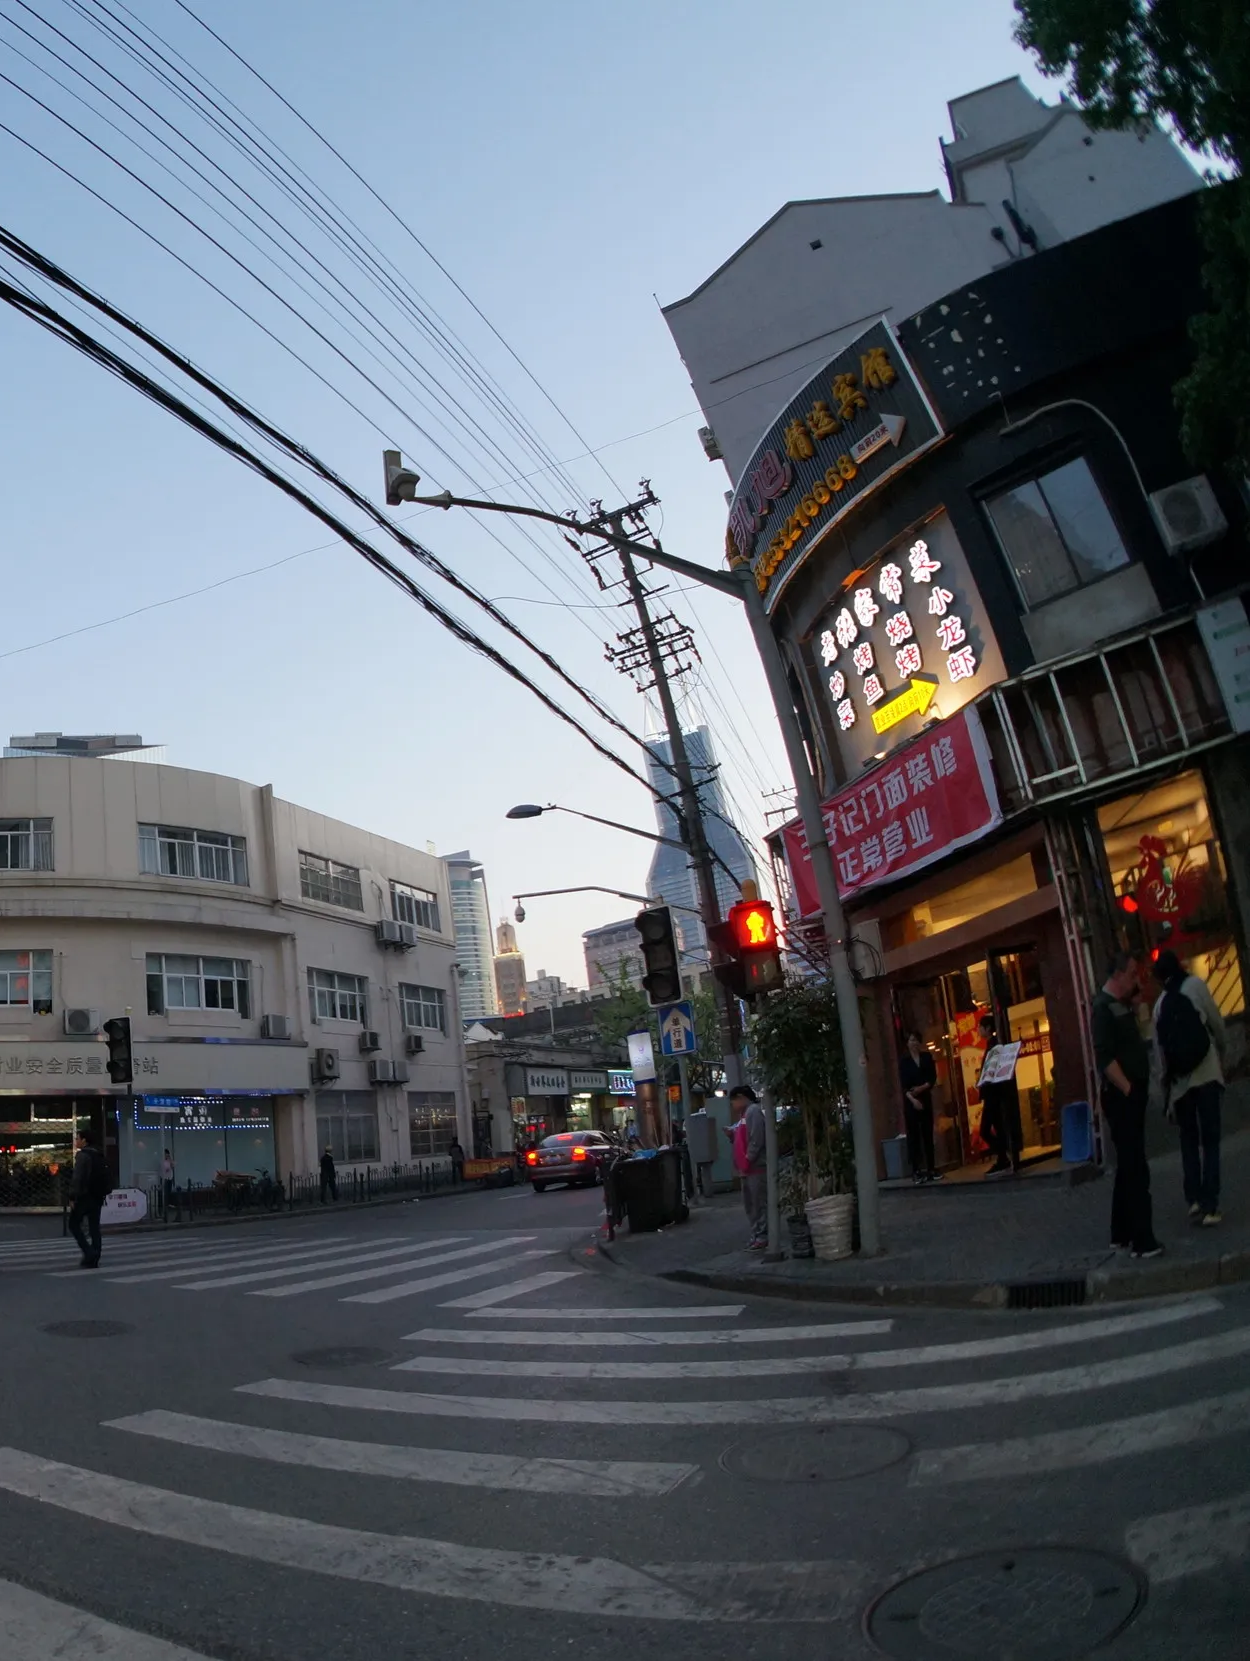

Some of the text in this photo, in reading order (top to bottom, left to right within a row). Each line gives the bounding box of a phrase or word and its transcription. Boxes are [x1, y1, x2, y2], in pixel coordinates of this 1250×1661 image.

[885, 611, 923, 679] 烧烤
[928, 586, 976, 683] 小龙虾
[829, 670, 857, 731] 炒菜
[853, 642, 886, 706] 烤鱼
[837, 806, 934, 885] 正常营业
[671, 1016, 684, 1049] 单行道
